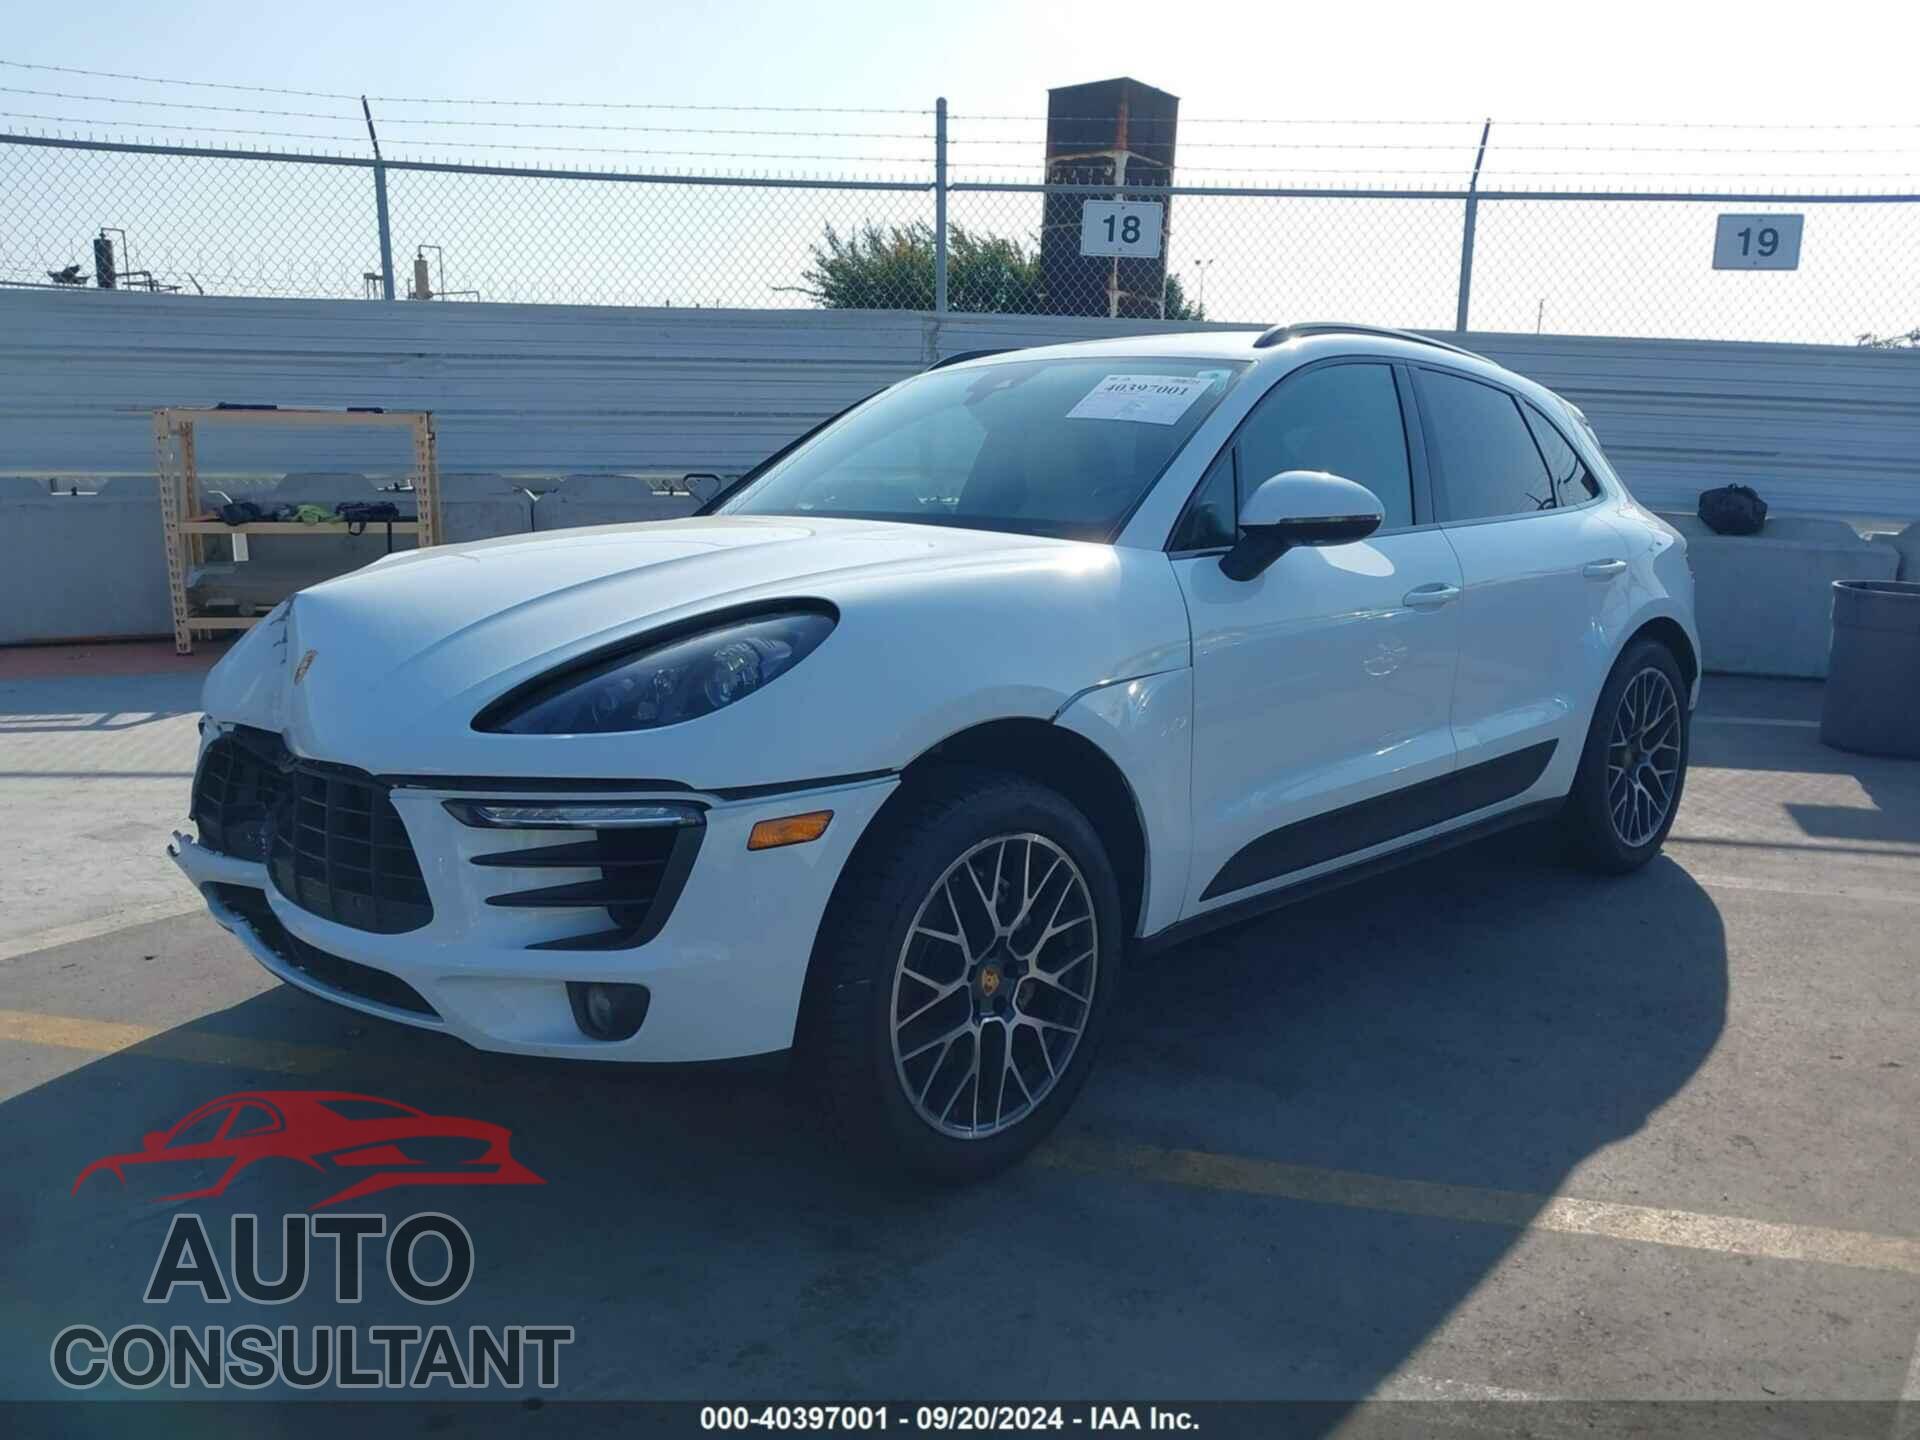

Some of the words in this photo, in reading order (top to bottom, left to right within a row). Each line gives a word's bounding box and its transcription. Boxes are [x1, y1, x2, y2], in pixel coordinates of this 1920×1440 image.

[1103, 214, 1141, 244] 18
[1737, 227, 1779, 257] 19
[1105, 383, 1190, 396] 40397001
